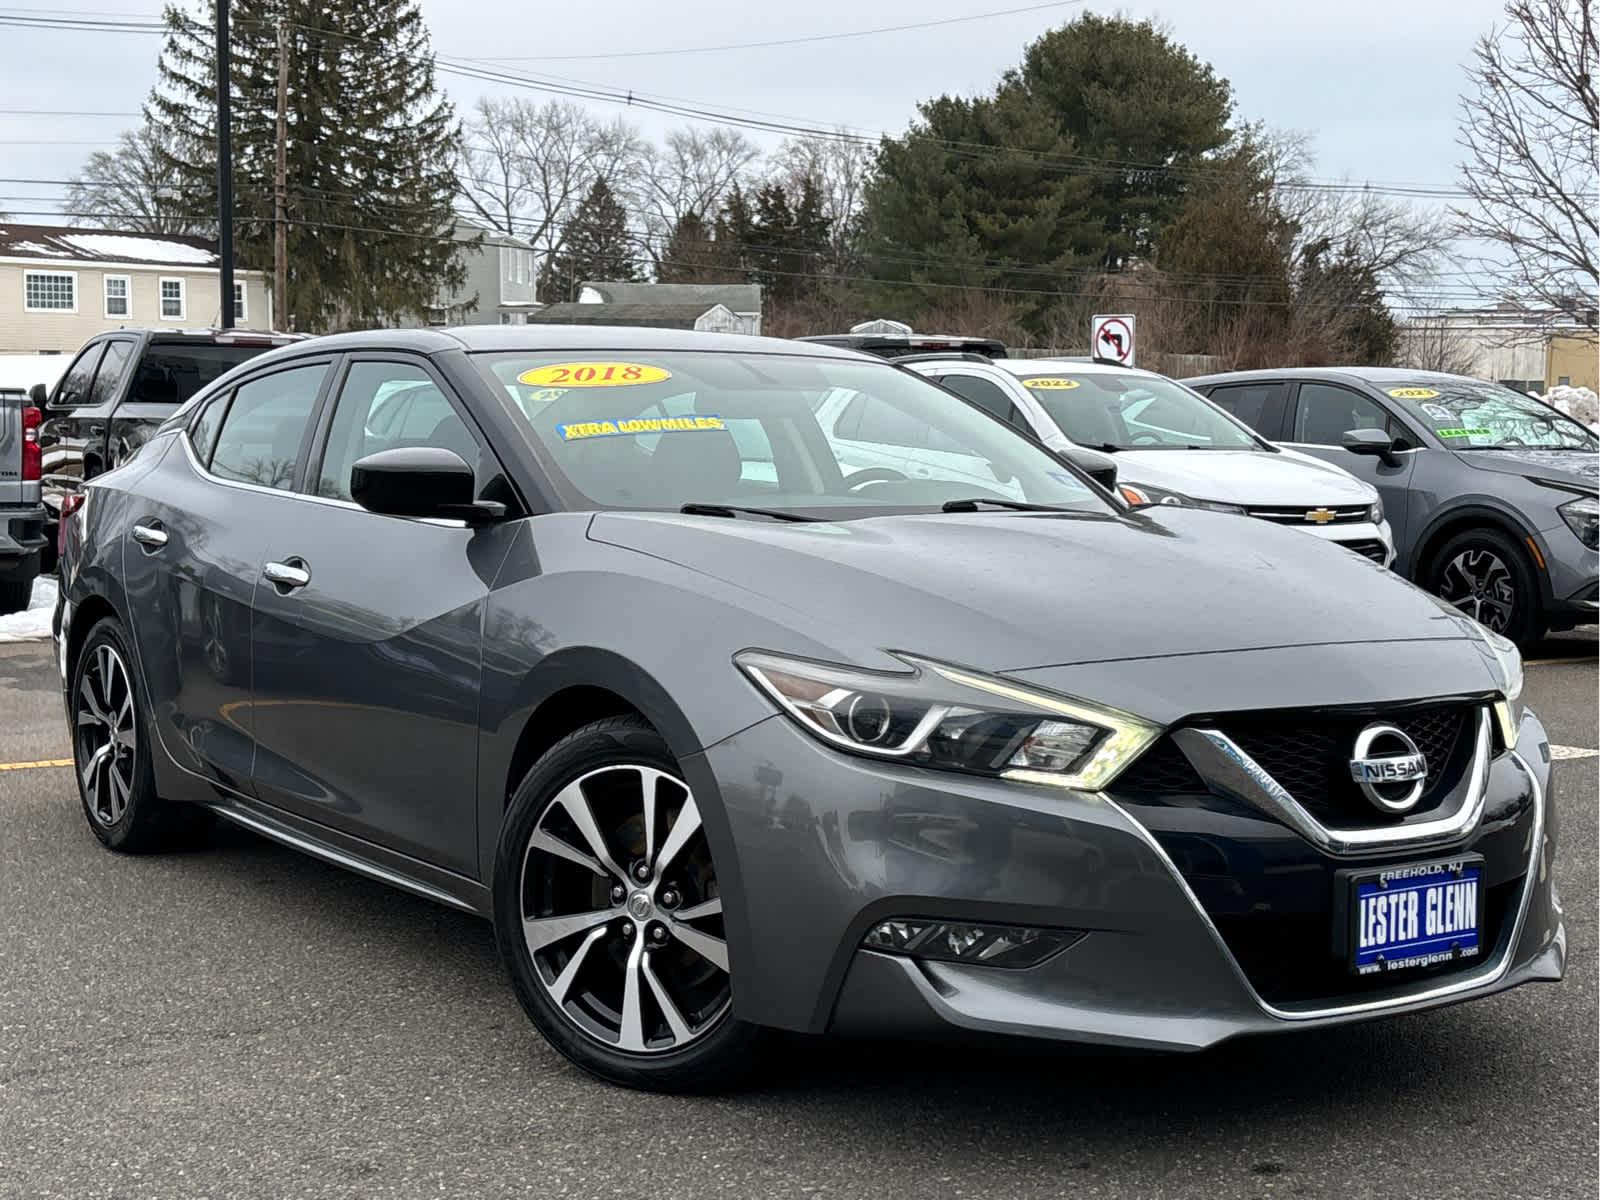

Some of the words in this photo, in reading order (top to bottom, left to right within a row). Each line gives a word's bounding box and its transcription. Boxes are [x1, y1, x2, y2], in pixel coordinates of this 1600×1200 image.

[549, 366, 642, 384] 2018
[562, 421, 619, 439] XTRA
[1364, 758, 1426, 778] NISSAN
[1379, 865, 1445, 881] FREEHOLD,
[1447, 862, 1464, 873] NJ
[1359, 891, 1419, 948] LESTER
[1425, 881, 1478, 936] GLENN
